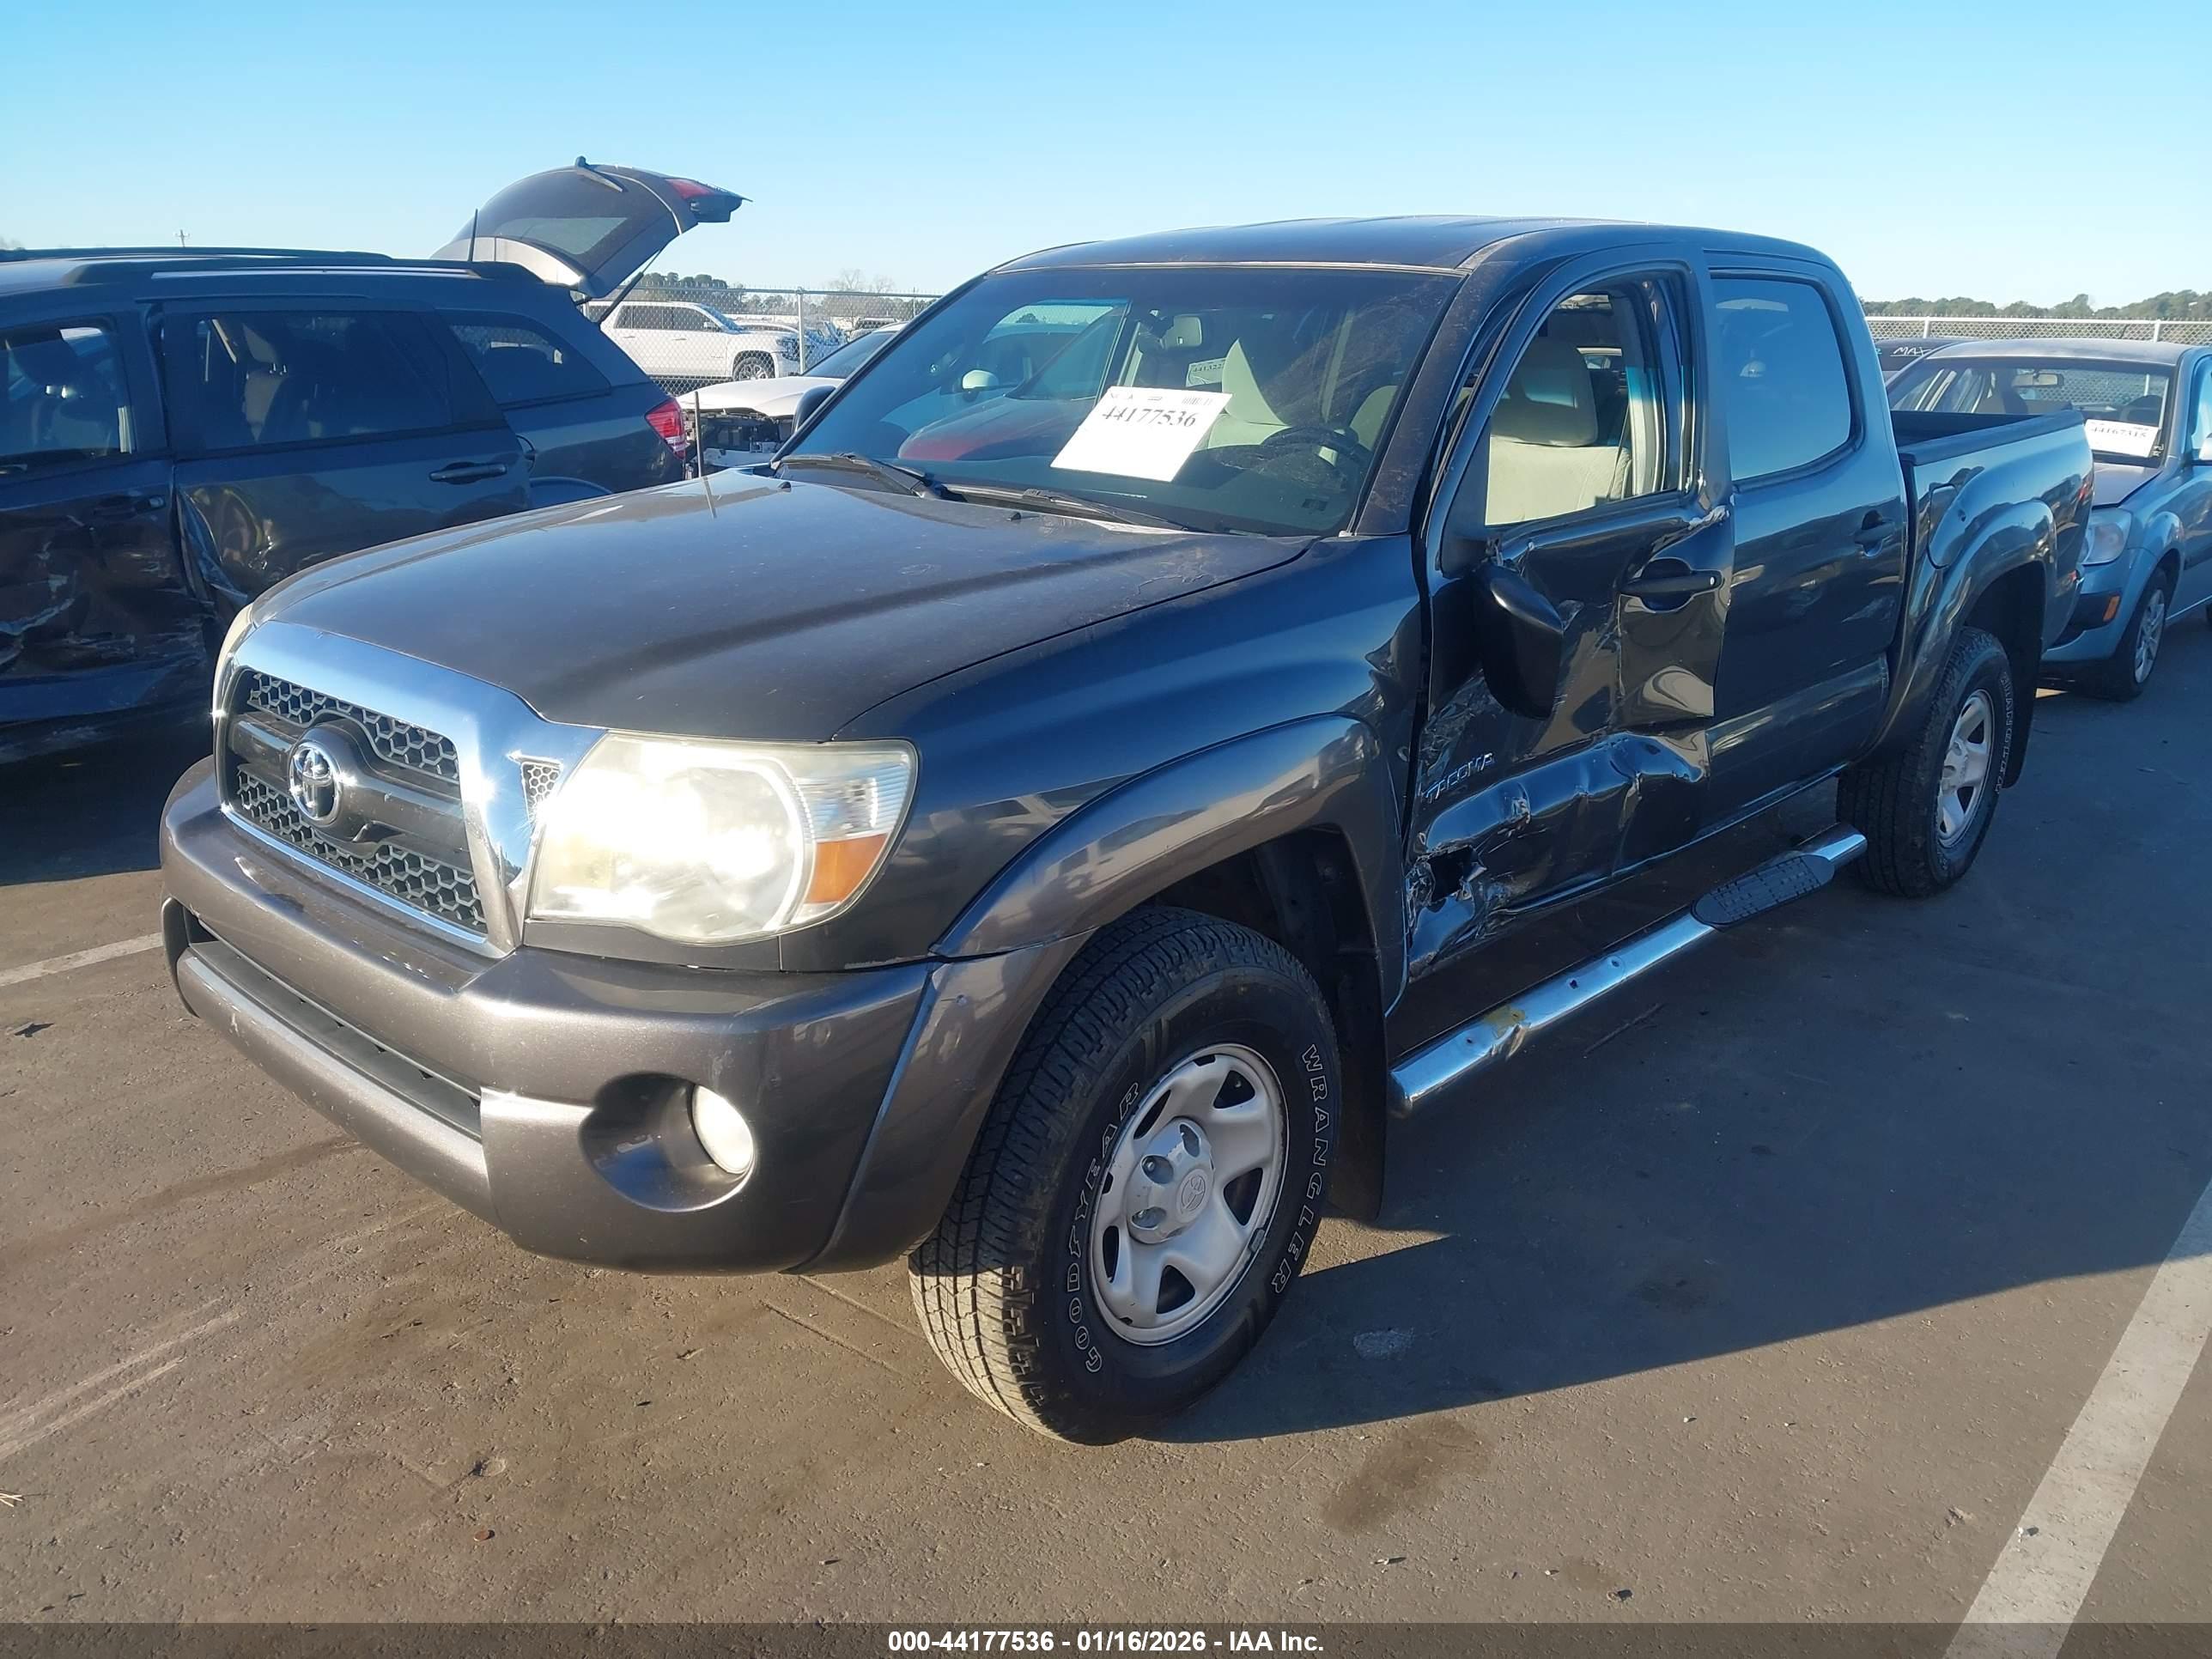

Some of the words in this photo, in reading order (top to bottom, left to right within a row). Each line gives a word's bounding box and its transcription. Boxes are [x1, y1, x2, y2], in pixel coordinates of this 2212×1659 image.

[1102, 406, 1197, 428] 44177536
[1067, 1082, 1139, 1373] GOODYEAR
[1271, 1044, 1329, 1294] WRANGLER
